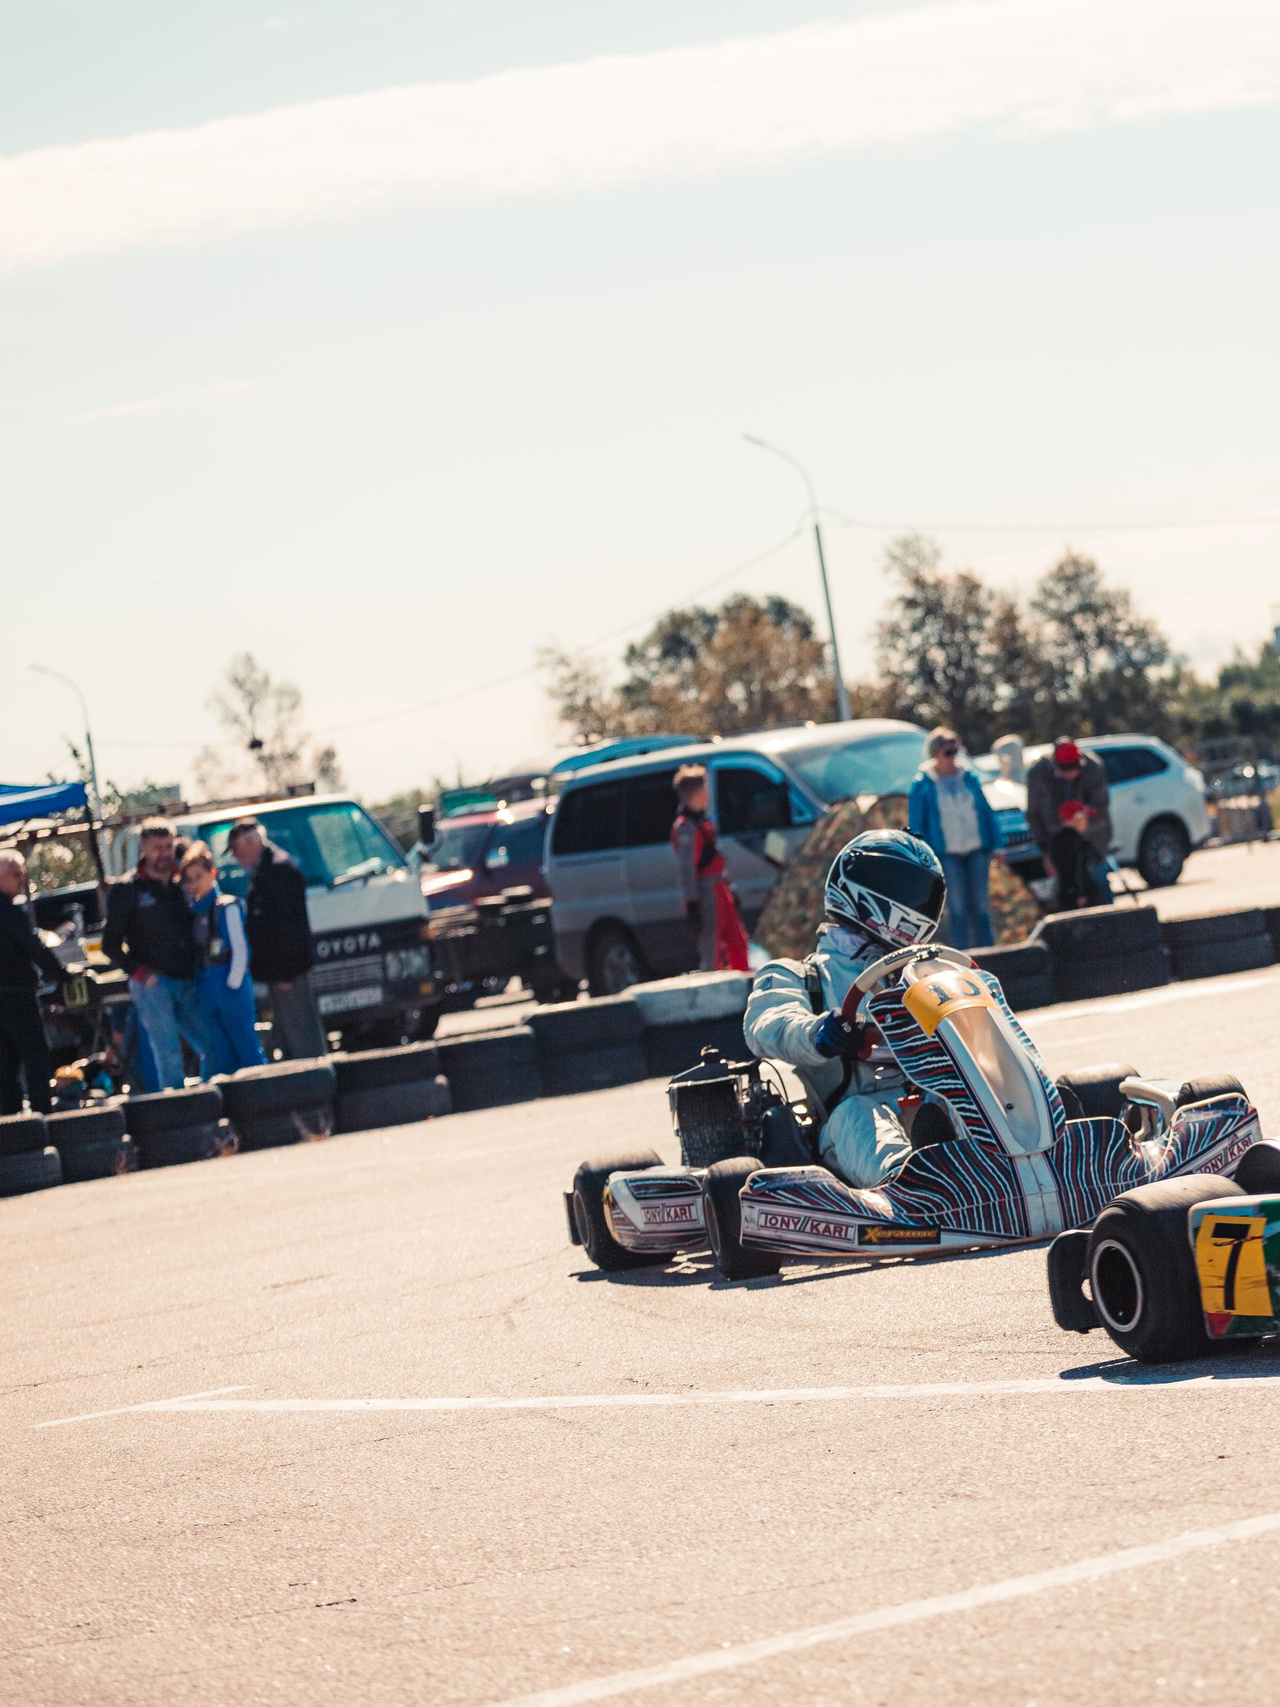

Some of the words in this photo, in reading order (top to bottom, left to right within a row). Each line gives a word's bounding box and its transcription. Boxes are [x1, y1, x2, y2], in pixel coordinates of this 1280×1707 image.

[317, 933, 380, 958] OYOTA
[761, 1212, 801, 1232] TONY
[809, 1218, 850, 1239] KART
[1211, 1222, 1252, 1310] 7
